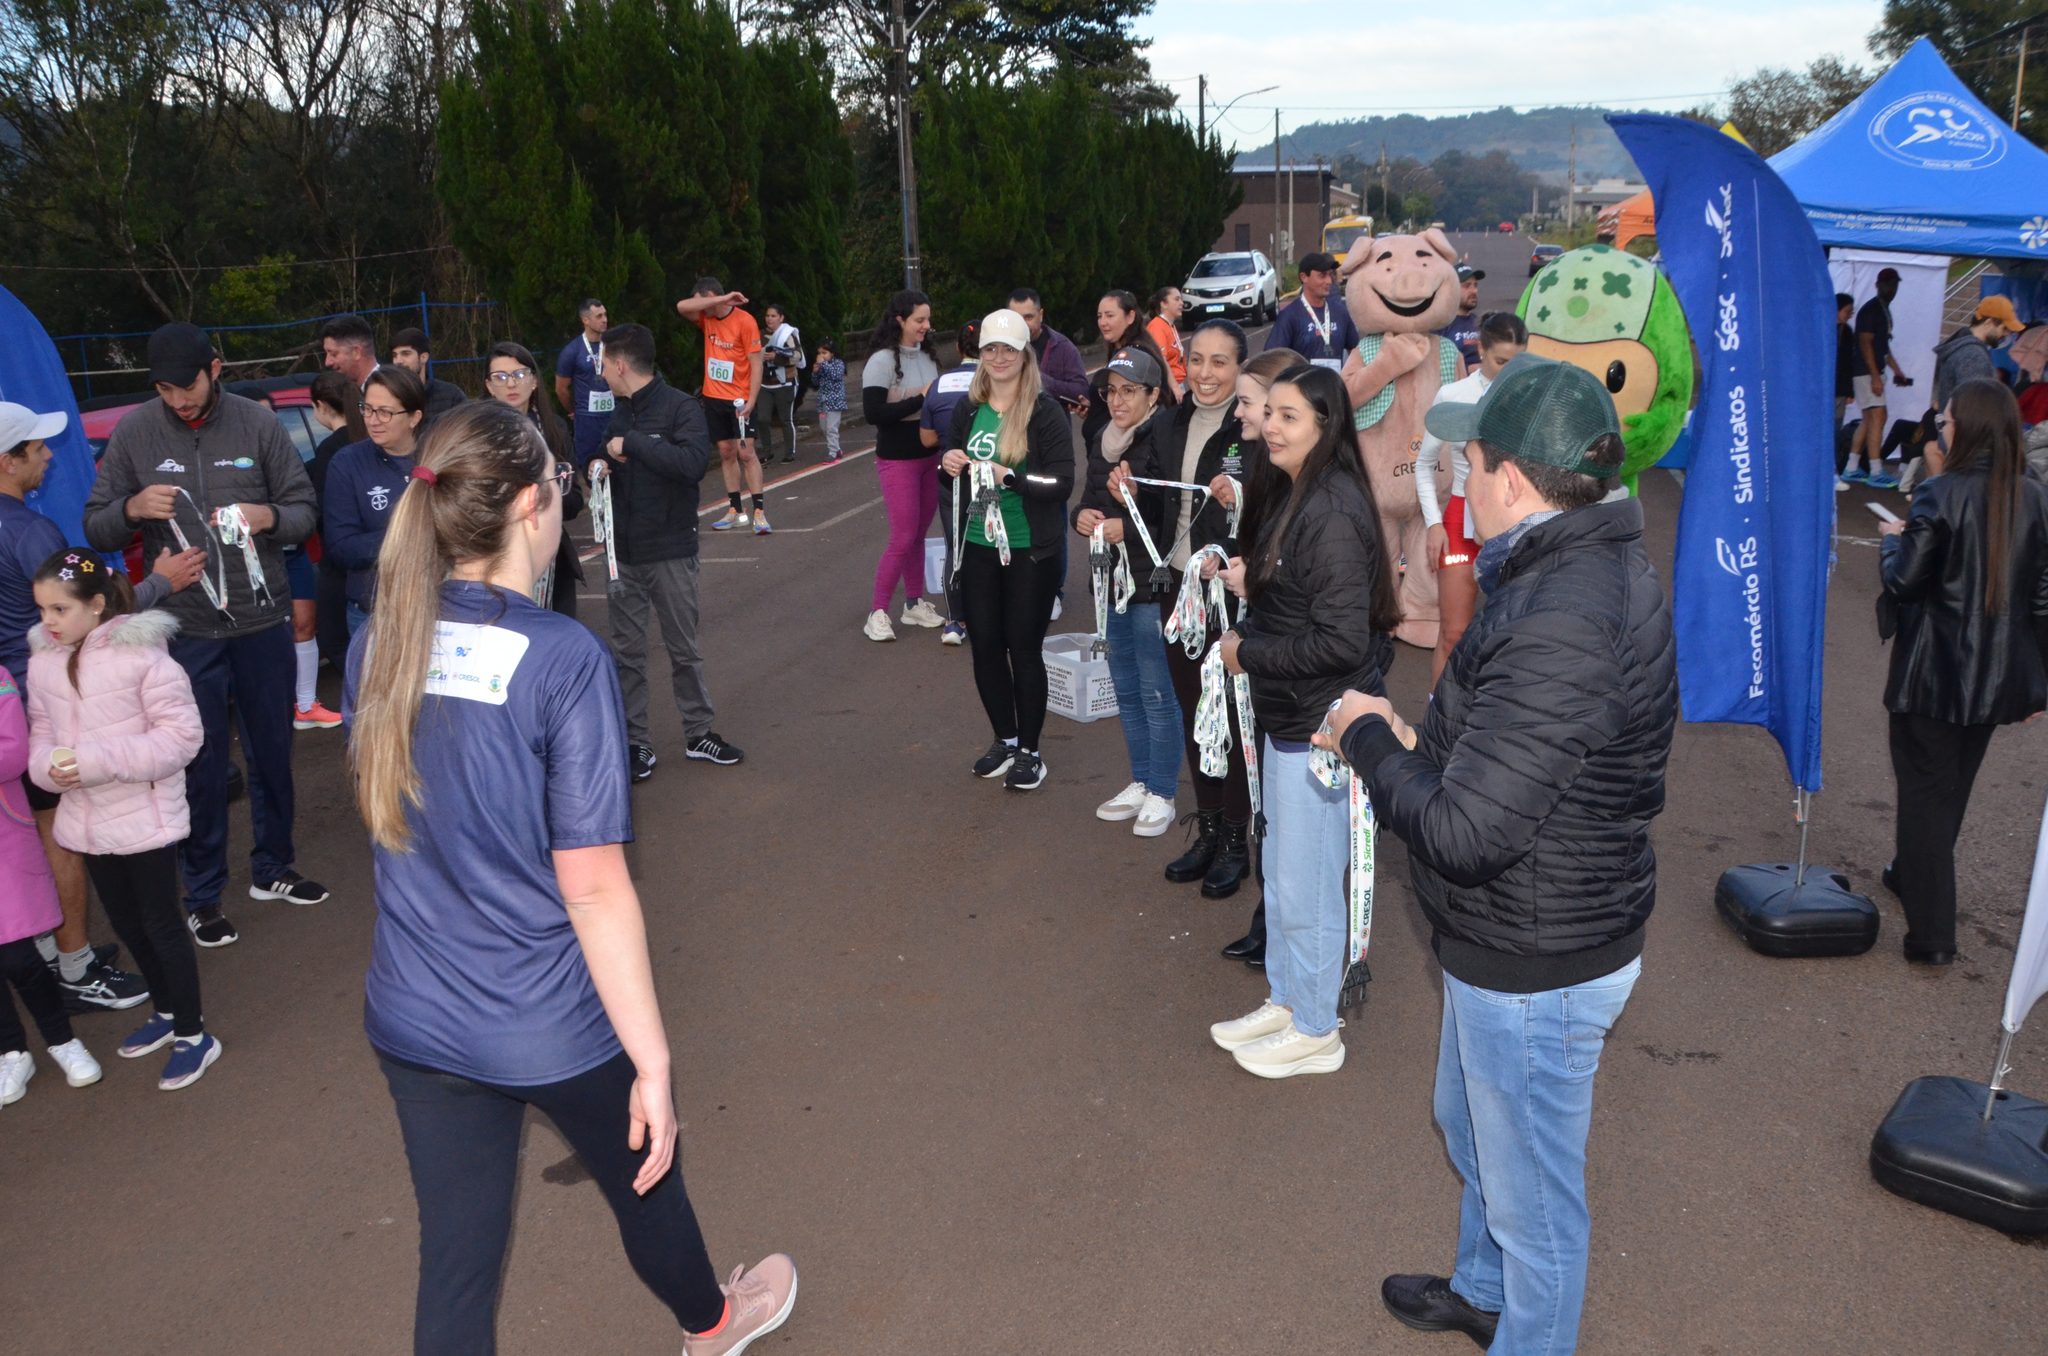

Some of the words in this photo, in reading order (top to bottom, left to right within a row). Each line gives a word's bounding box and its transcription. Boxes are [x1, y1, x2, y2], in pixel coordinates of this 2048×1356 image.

[1717, 292, 1740, 351] Sesc
[710, 366, 729, 380] 160
[593, 399, 613, 410] 189
[966, 430, 997, 460] 45
[1729, 385, 1753, 504] Sindicatos
[1393, 461, 1445, 477] CREL
[1739, 536, 1758, 568] RS
[1742, 574, 1764, 699] Fecomércio
[458, 674, 480, 683] CRESOL
[1092, 695, 1116, 704] DESCART
[1239, 700, 1247, 729] CRESOL
[1363, 886, 1372, 926] CRESOL
